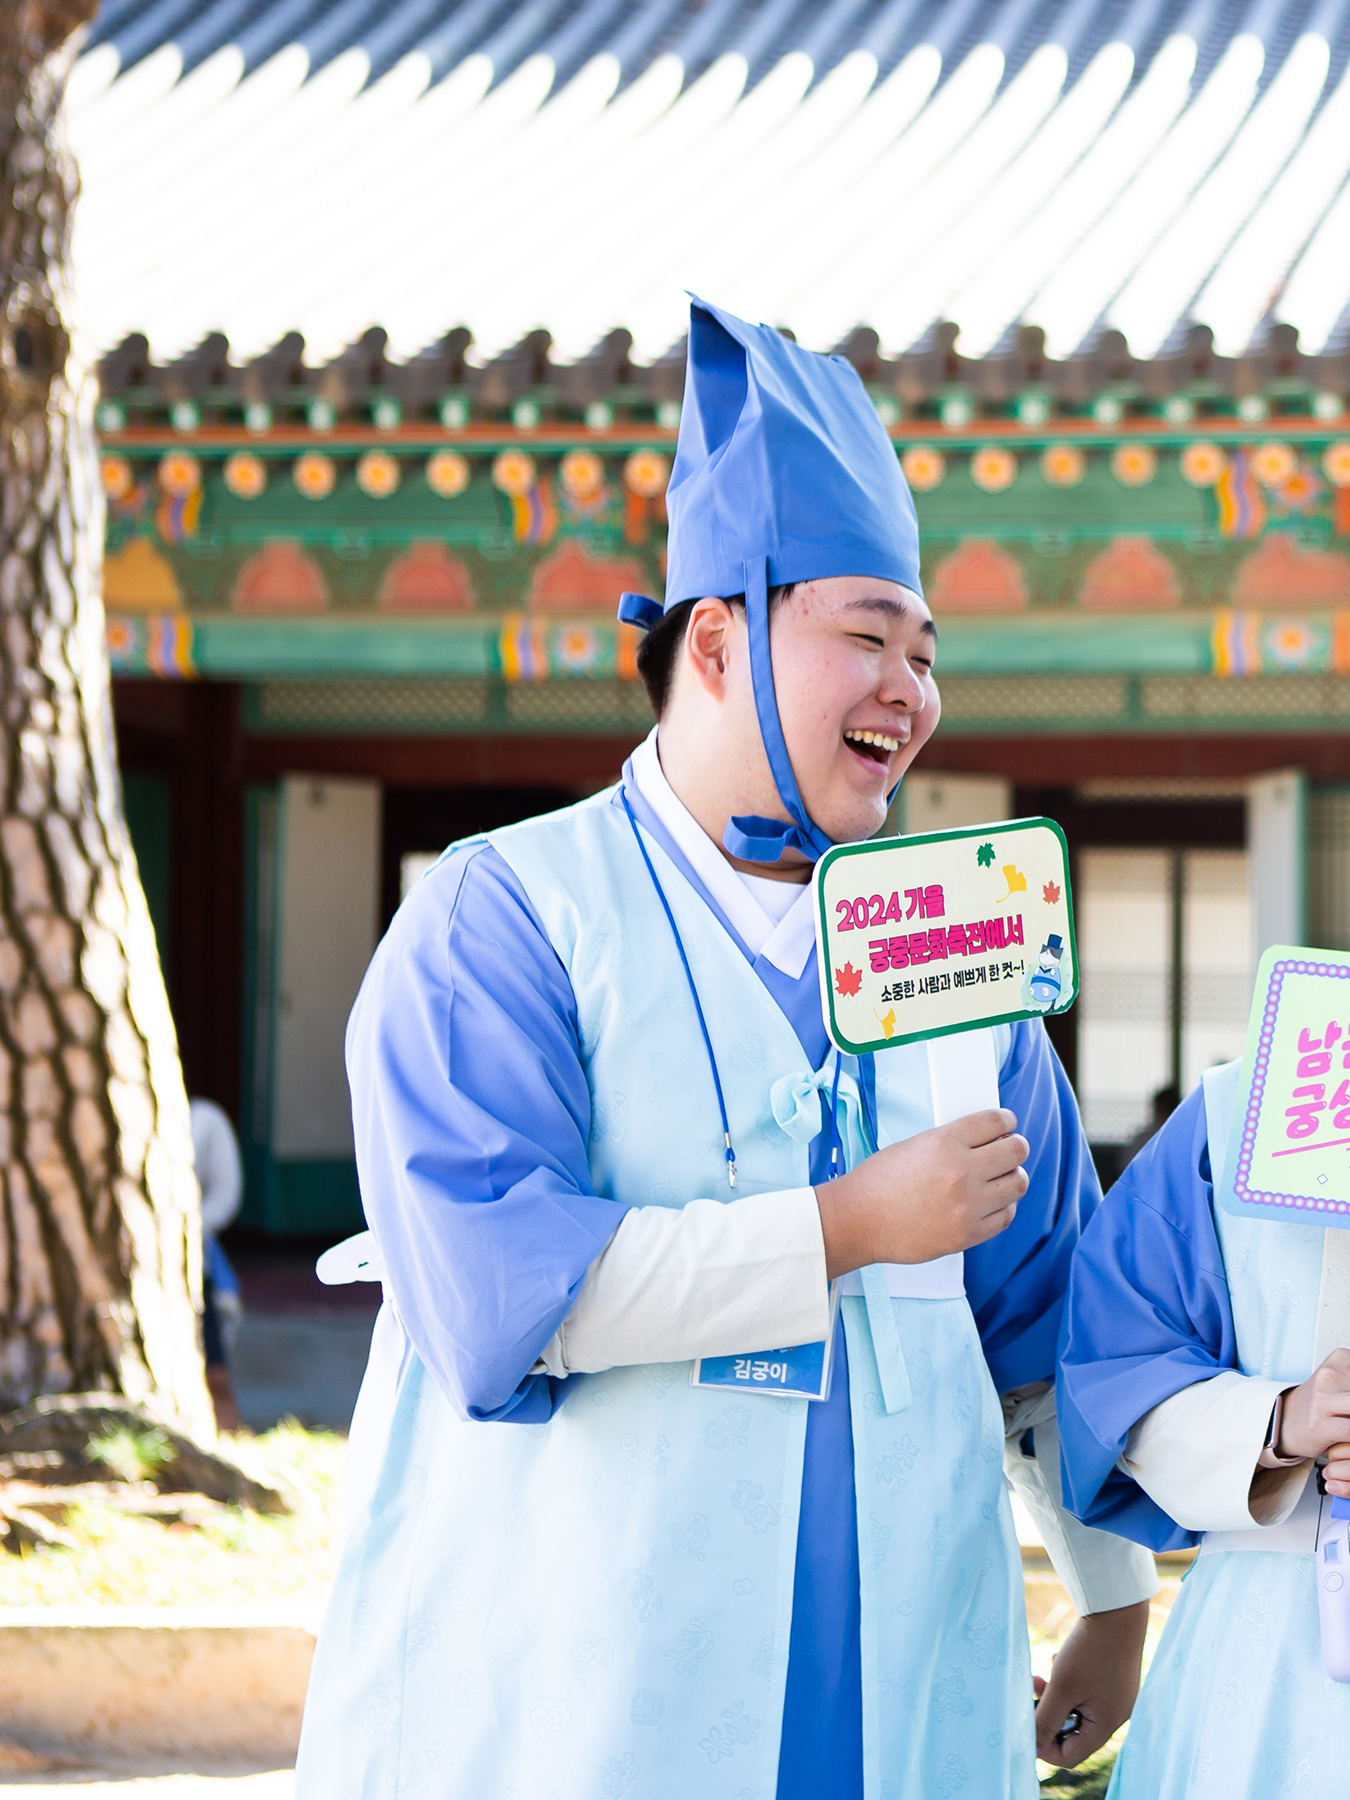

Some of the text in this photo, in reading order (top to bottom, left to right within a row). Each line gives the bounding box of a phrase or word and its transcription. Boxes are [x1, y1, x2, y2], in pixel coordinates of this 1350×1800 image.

[835, 884, 946, 932] 2024 가을
[868, 913, 1025, 973] 궁중문화축전에서
[881, 979, 915, 1003] 소중한
[918, 974, 951, 996] 사람과
[953, 966, 987, 989] 예쁘게
[988, 964, 1001, 982] 한
[733, 1359, 787, 1383] 김궁이
